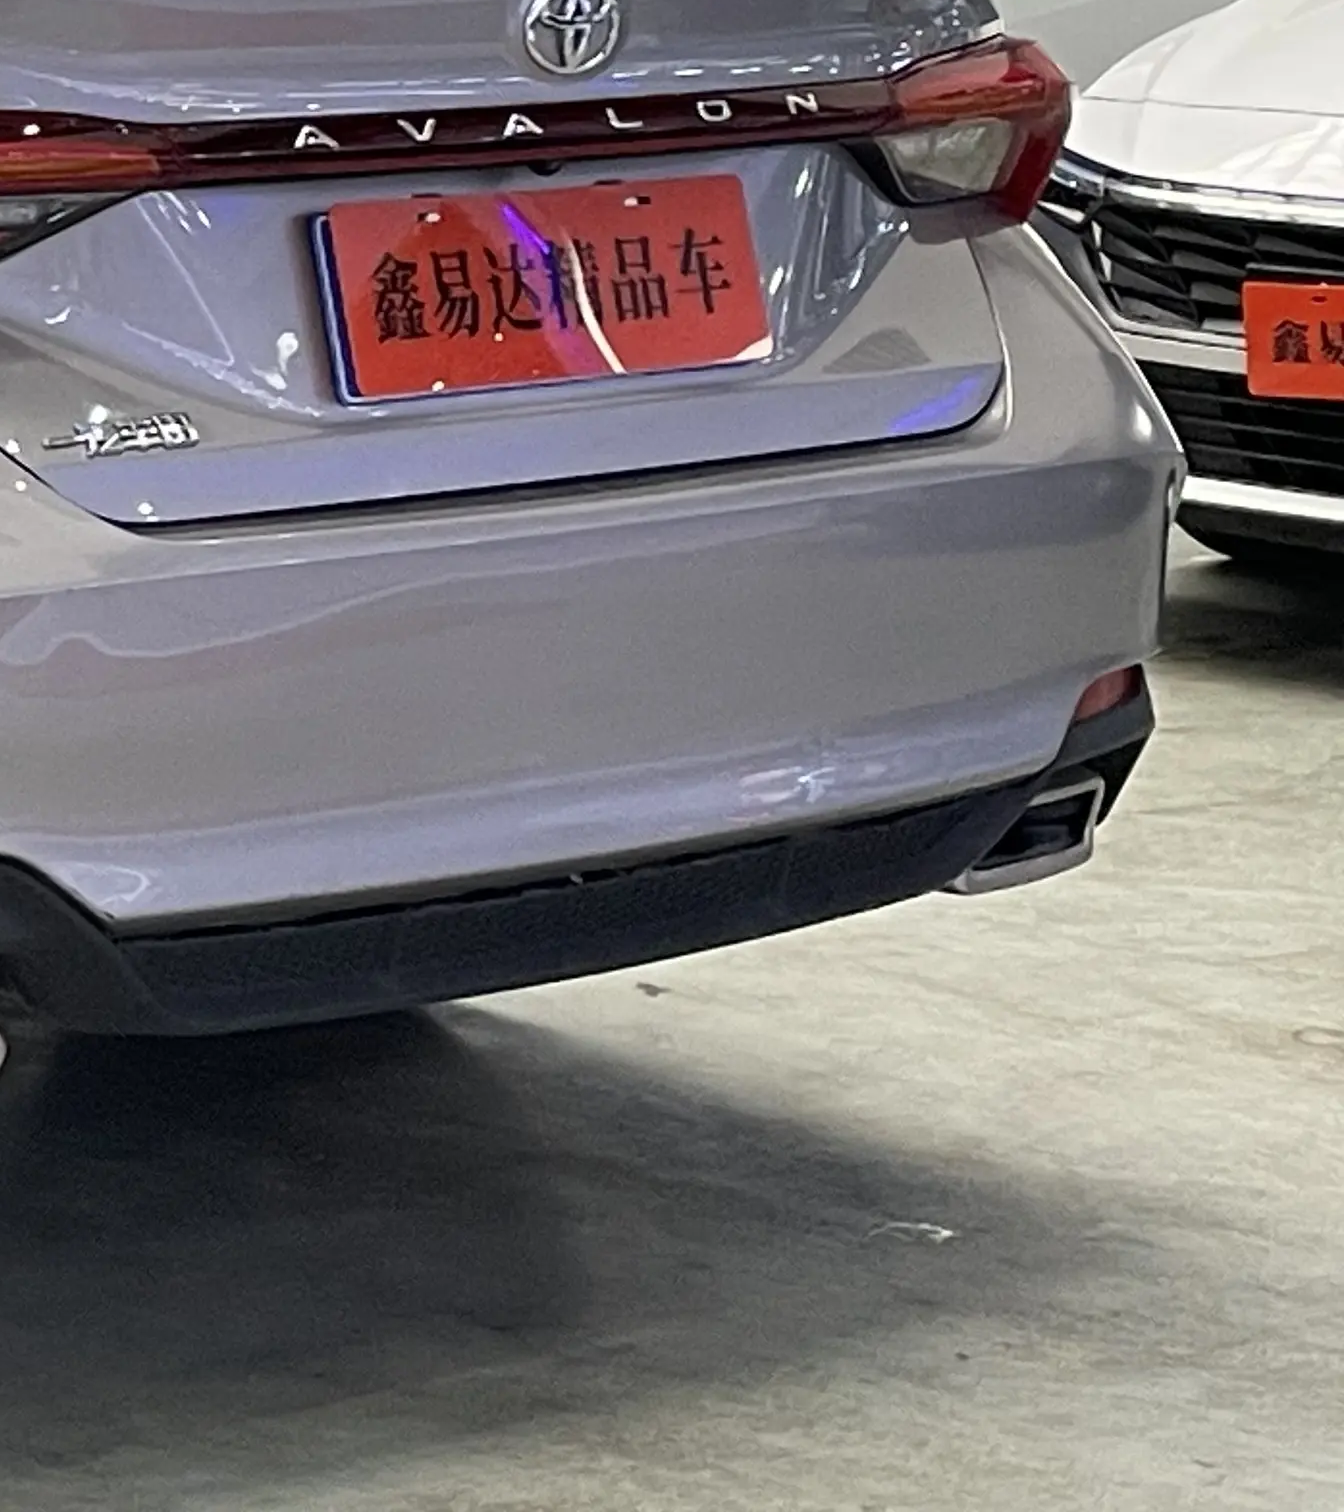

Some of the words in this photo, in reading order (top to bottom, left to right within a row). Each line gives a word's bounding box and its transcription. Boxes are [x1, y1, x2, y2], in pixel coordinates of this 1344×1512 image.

[295, 91, 821, 153] AVALON
[372, 227, 731, 344] 鑫易达精品车
